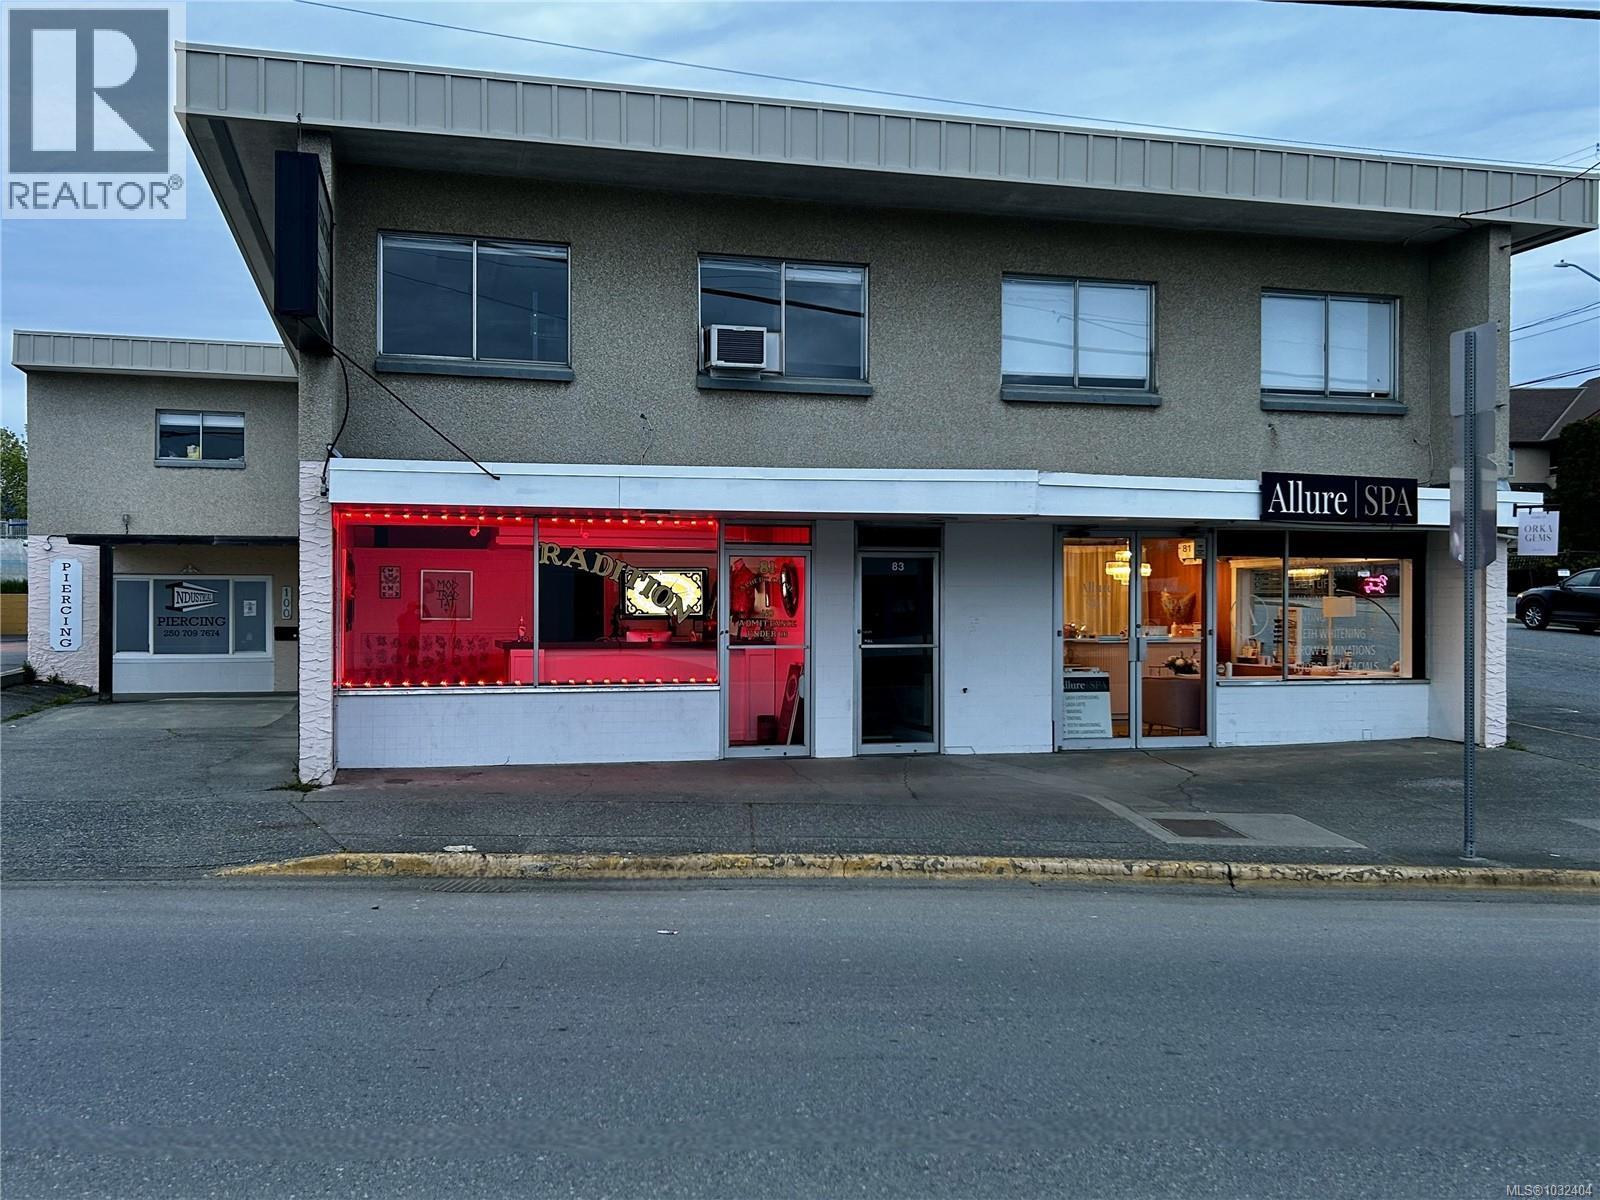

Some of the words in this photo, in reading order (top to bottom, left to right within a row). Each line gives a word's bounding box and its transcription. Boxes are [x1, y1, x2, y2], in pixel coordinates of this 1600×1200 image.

[1268, 480, 1348, 515] Allure
[1364, 484, 1413, 516] SPA
[1524, 524, 1552, 533] ORKA
[1524, 534, 1552, 542] GEMS
[760, 561, 775, 574] 81
[891, 561, 905, 571] 83
[59, 562, 73, 648] PIERCING
[157, 616, 226, 627] PIERCING
